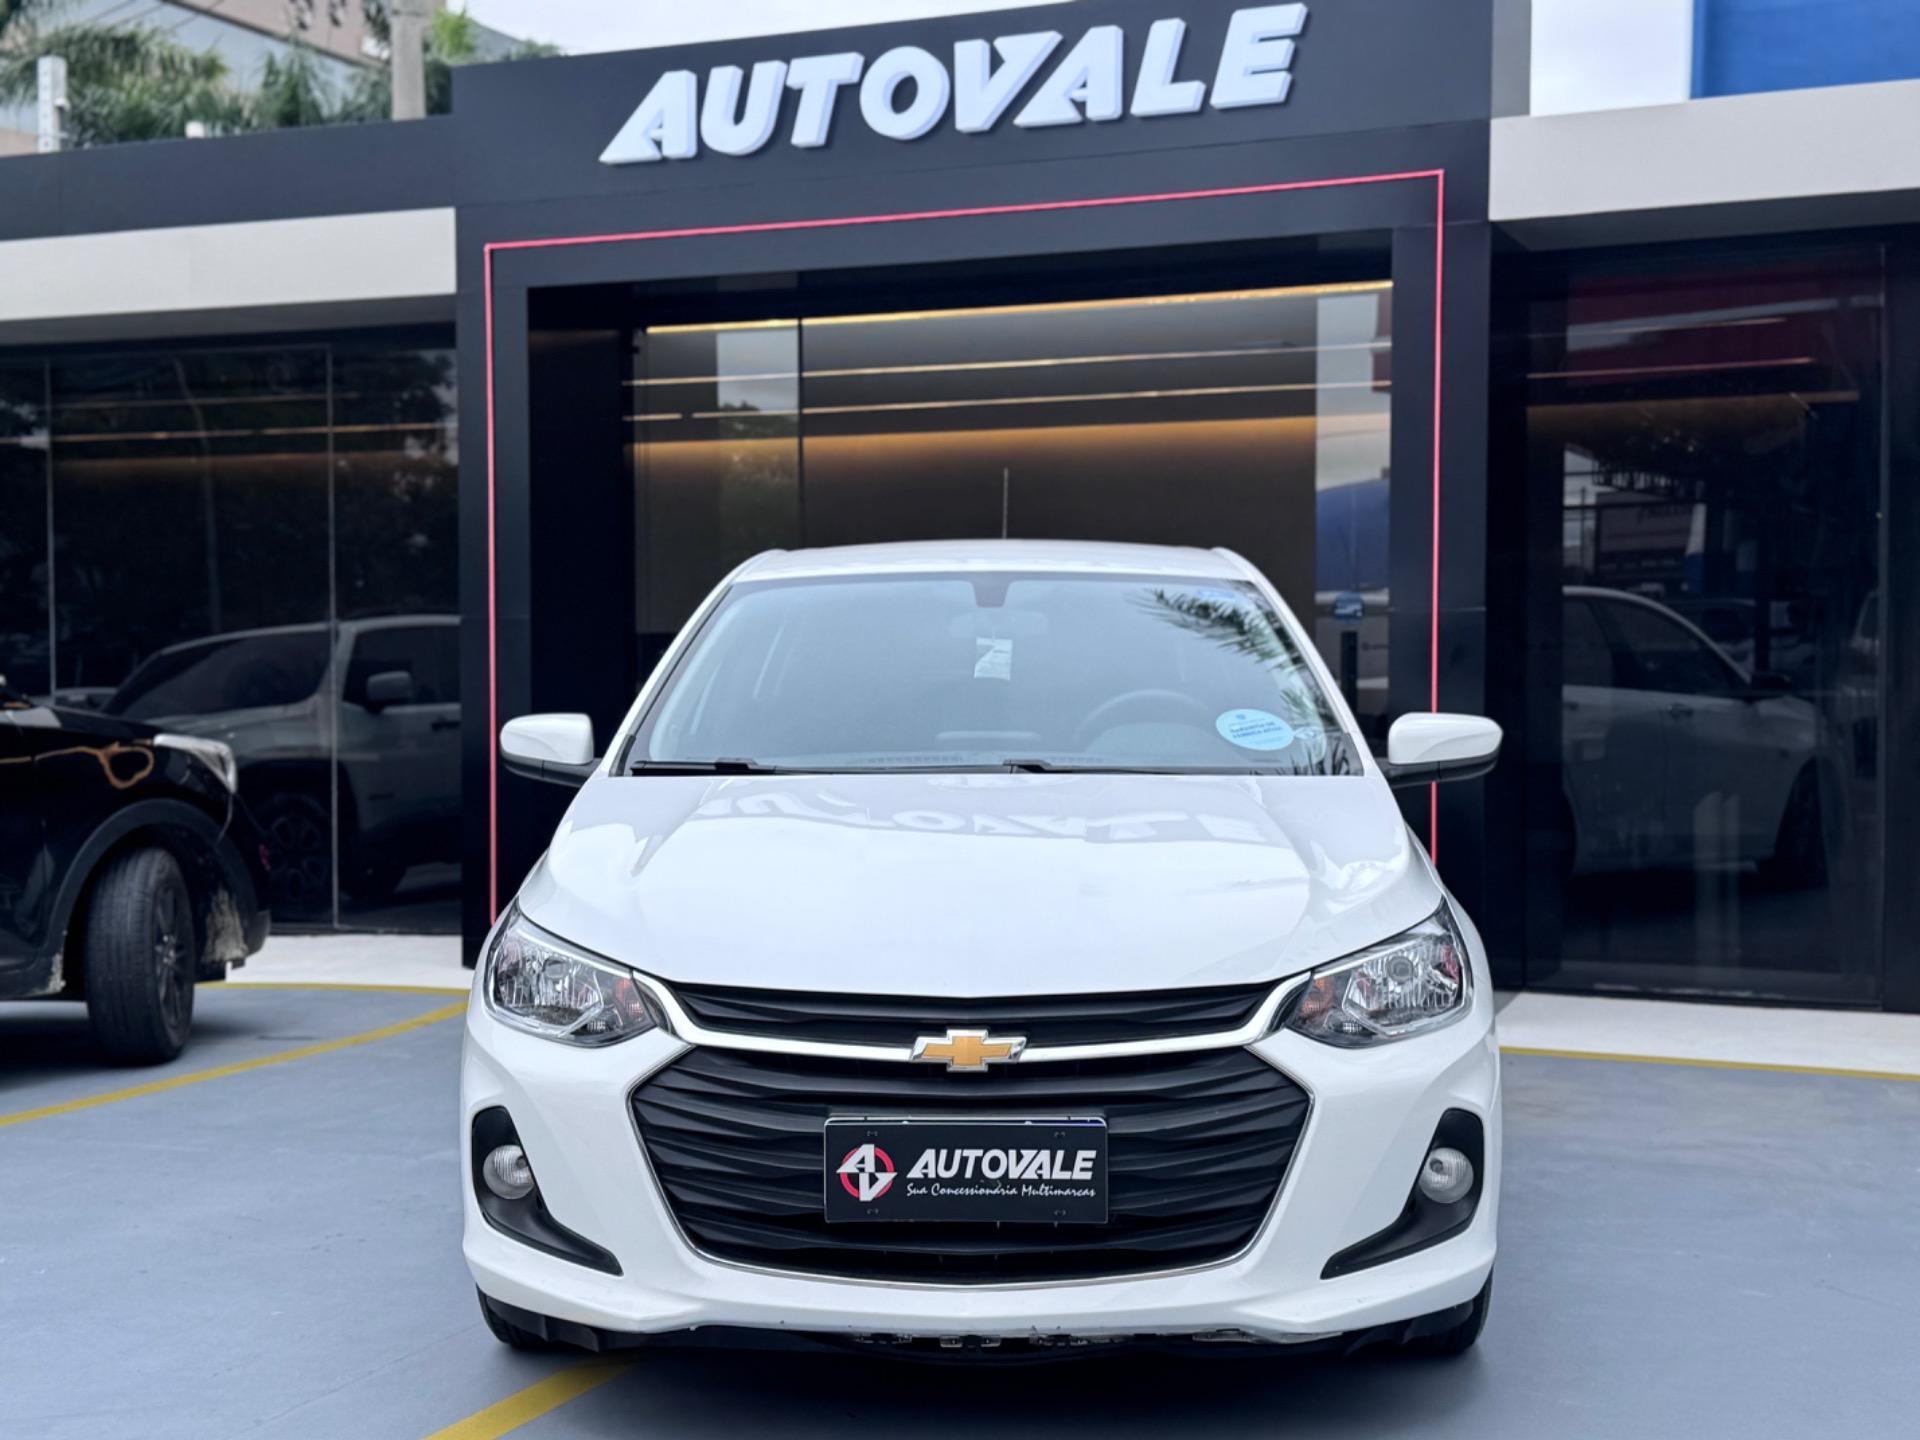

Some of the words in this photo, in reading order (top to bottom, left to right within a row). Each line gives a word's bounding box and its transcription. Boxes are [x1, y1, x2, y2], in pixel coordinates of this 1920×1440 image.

[599, 3, 1308, 164] AUTOVALE
[906, 1149, 1097, 1180] AUTOVALE
[906, 1182, 928, 1197] Sua
[931, 1180, 1018, 1197] Concessionária
[1021, 1182, 1096, 1198] Multimarcas
